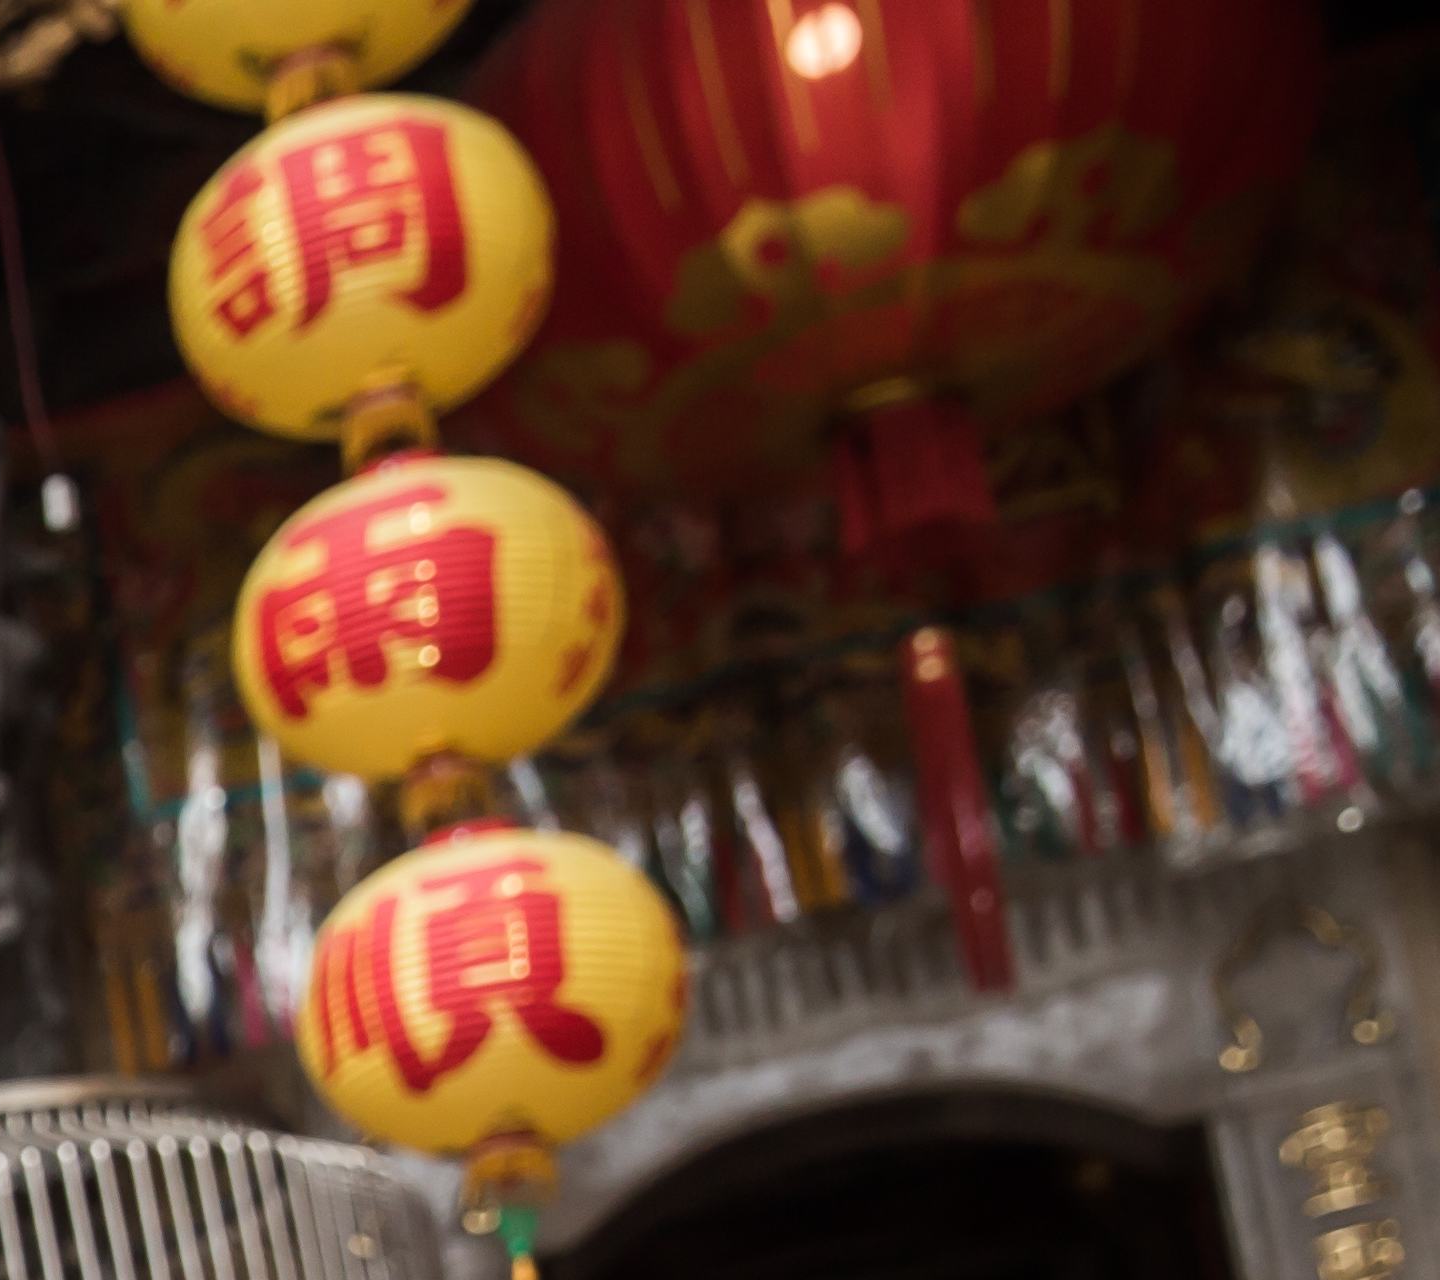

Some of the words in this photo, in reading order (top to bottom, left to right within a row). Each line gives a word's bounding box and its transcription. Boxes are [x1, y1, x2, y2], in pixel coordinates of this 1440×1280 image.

[198, 115, 470, 337] 調
[254, 483, 500, 720] 雨
[308, 856, 608, 1096] 順
